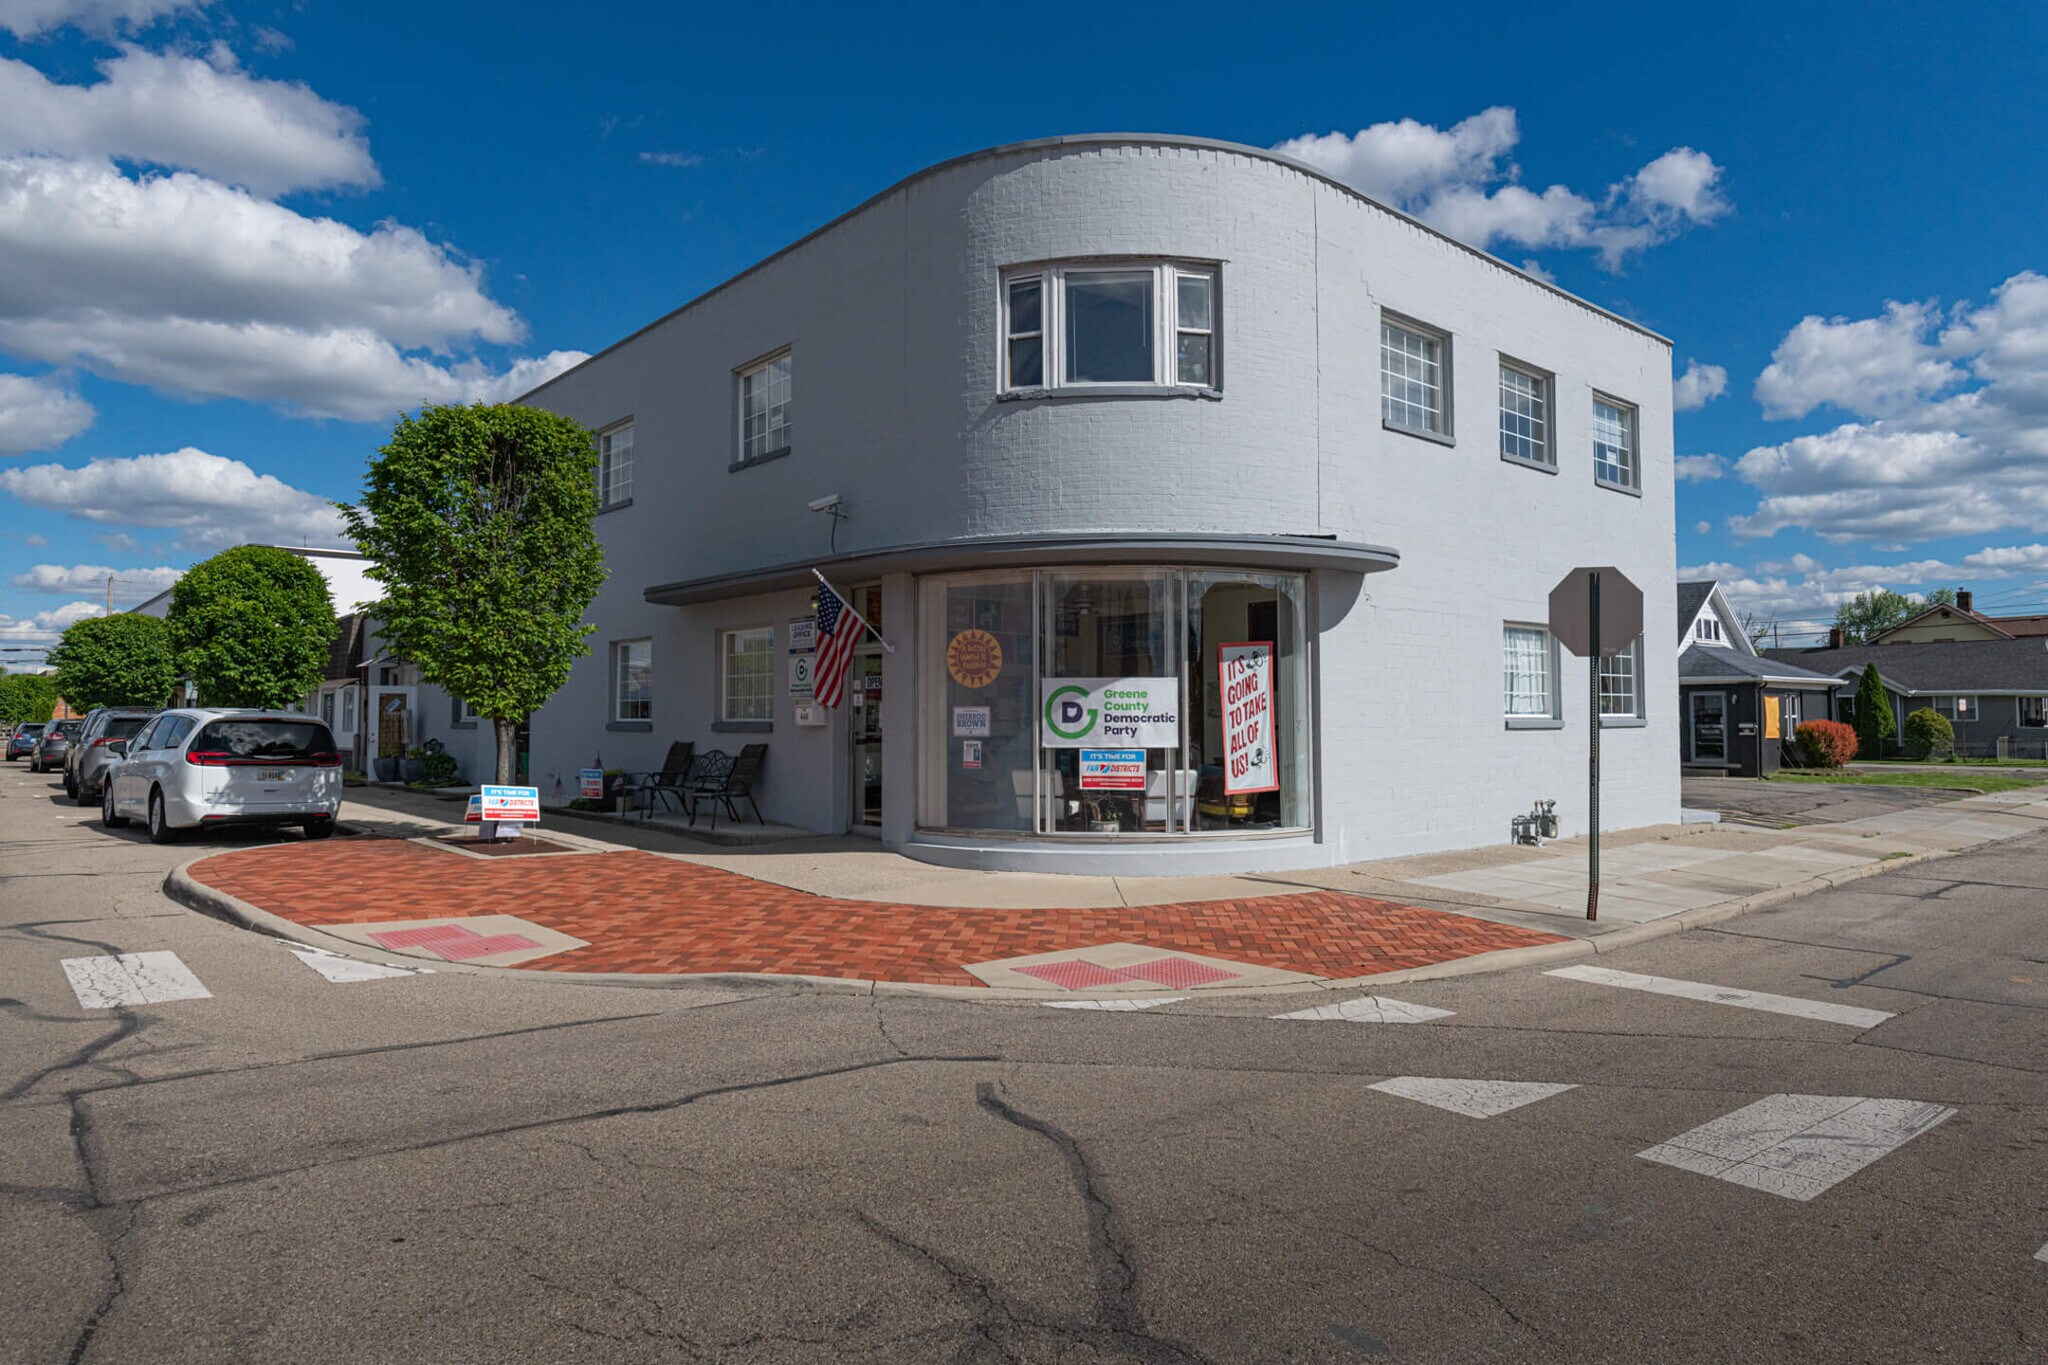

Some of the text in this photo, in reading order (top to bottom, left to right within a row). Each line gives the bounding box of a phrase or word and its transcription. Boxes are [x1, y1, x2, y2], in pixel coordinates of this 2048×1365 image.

[1104, 689, 1148, 699] Greene
[1227, 673, 1258, 705] GOING
[1104, 701, 1149, 713] County
[1229, 691, 1267, 729] TO TAKE
[1104, 712, 1175, 723] Democratic
[957, 720, 986, 728] BROWN
[1104, 726, 1138, 738] Party
[1231, 720, 1259, 755] ALL OF
[1086, 765, 1140, 773] FAIR DISTRICTS
[1231, 752, 1249, 779] US!
